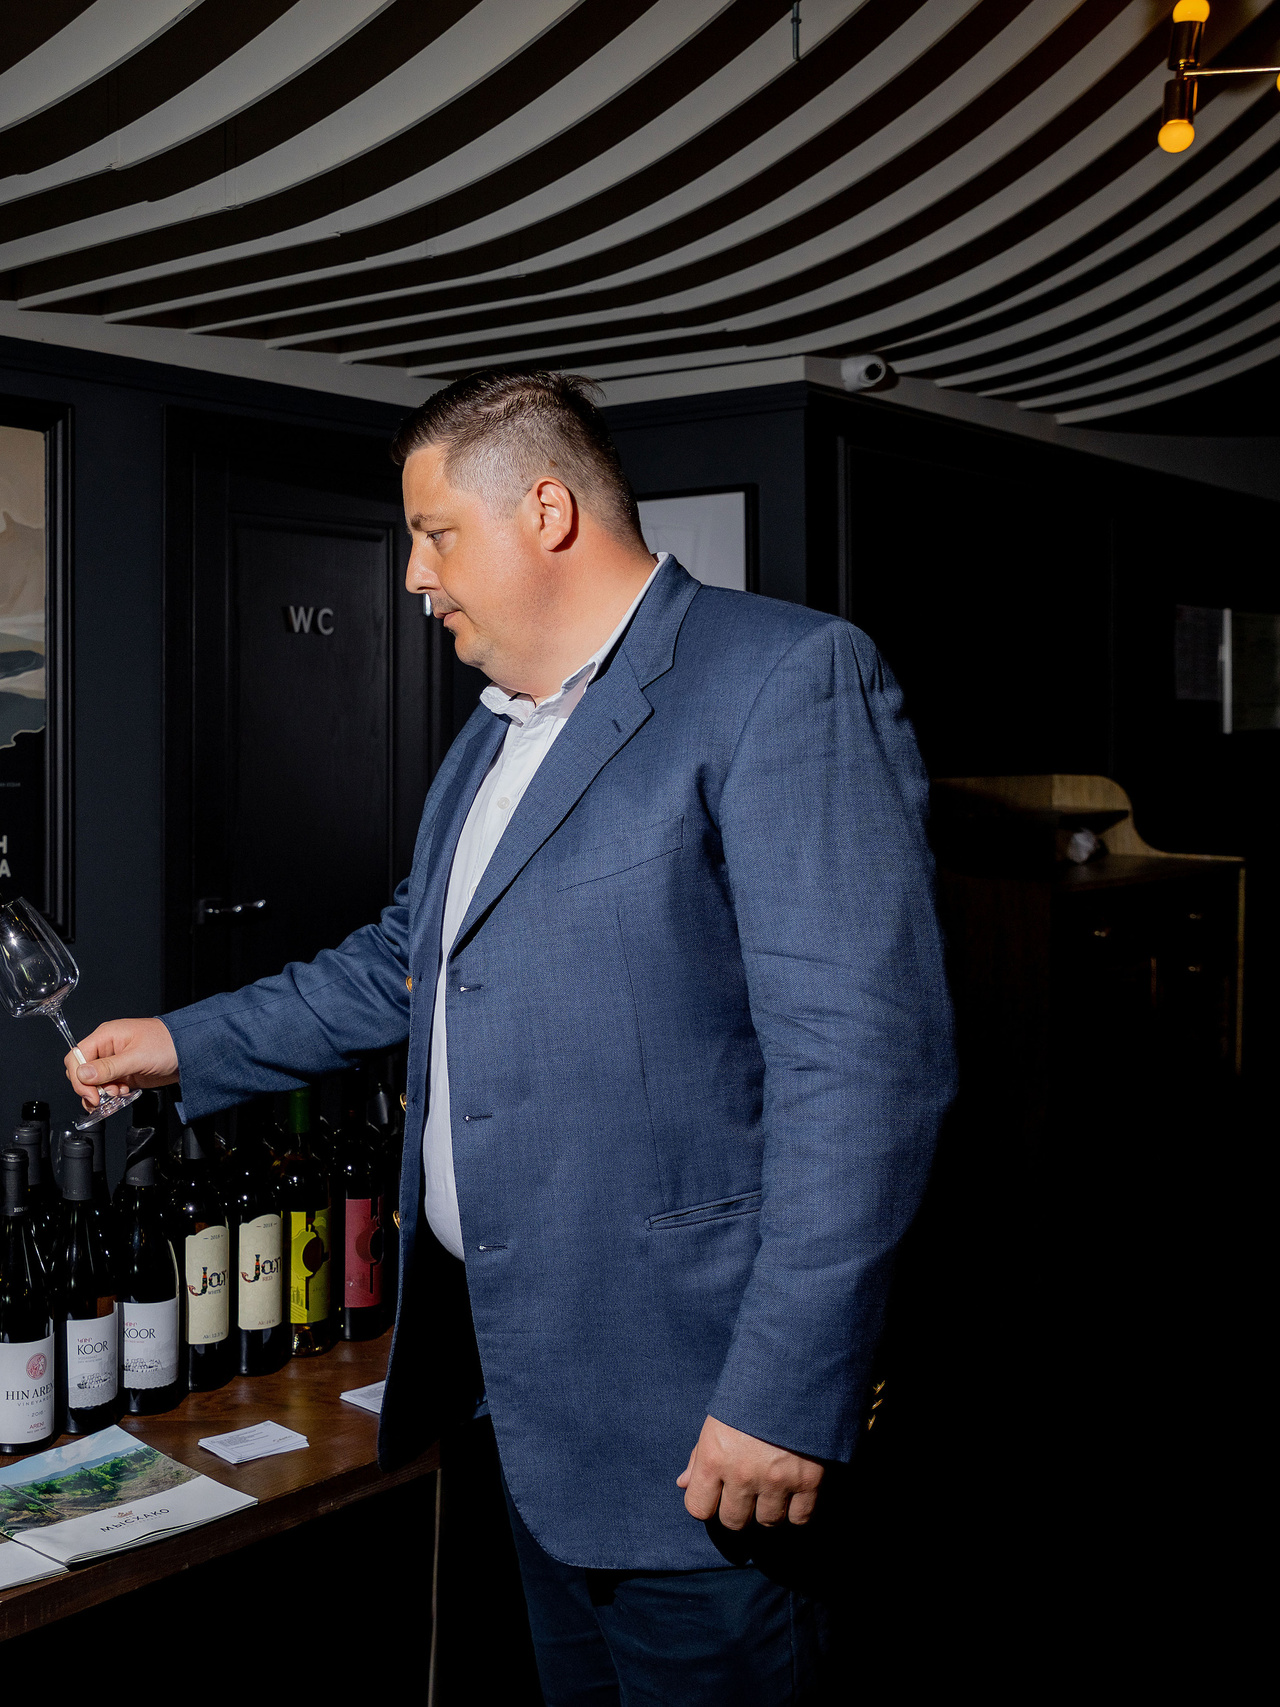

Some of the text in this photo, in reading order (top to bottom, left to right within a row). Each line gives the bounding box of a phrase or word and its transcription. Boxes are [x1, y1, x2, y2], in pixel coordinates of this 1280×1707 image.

[288, 605, 335, 636] WC
[77, 1340, 109, 1356] KOOR
[6, 1390, 30, 1400] HIN
[100, 1508, 170, 1533] МЫСХАКО
